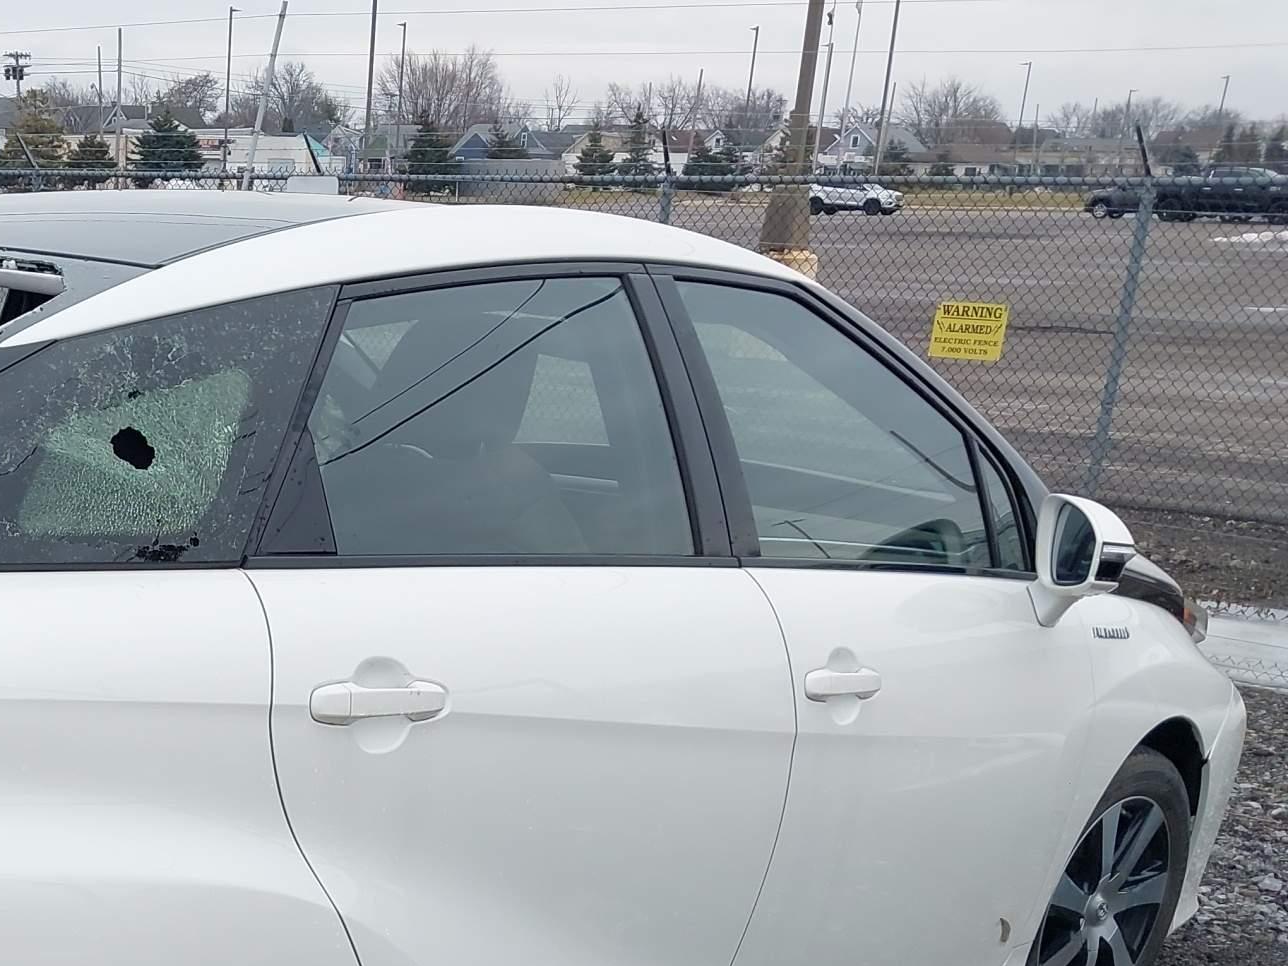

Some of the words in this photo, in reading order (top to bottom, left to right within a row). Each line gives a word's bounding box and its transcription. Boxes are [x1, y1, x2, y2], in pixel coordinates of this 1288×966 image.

[943, 304, 1003, 319] WARNING
[945, 323, 992, 335] ALARMED
[934, 337, 971, 345] ELECTRIC
[972, 339, 1000, 347] FENCE
[963, 347, 988, 355] VOLTS
